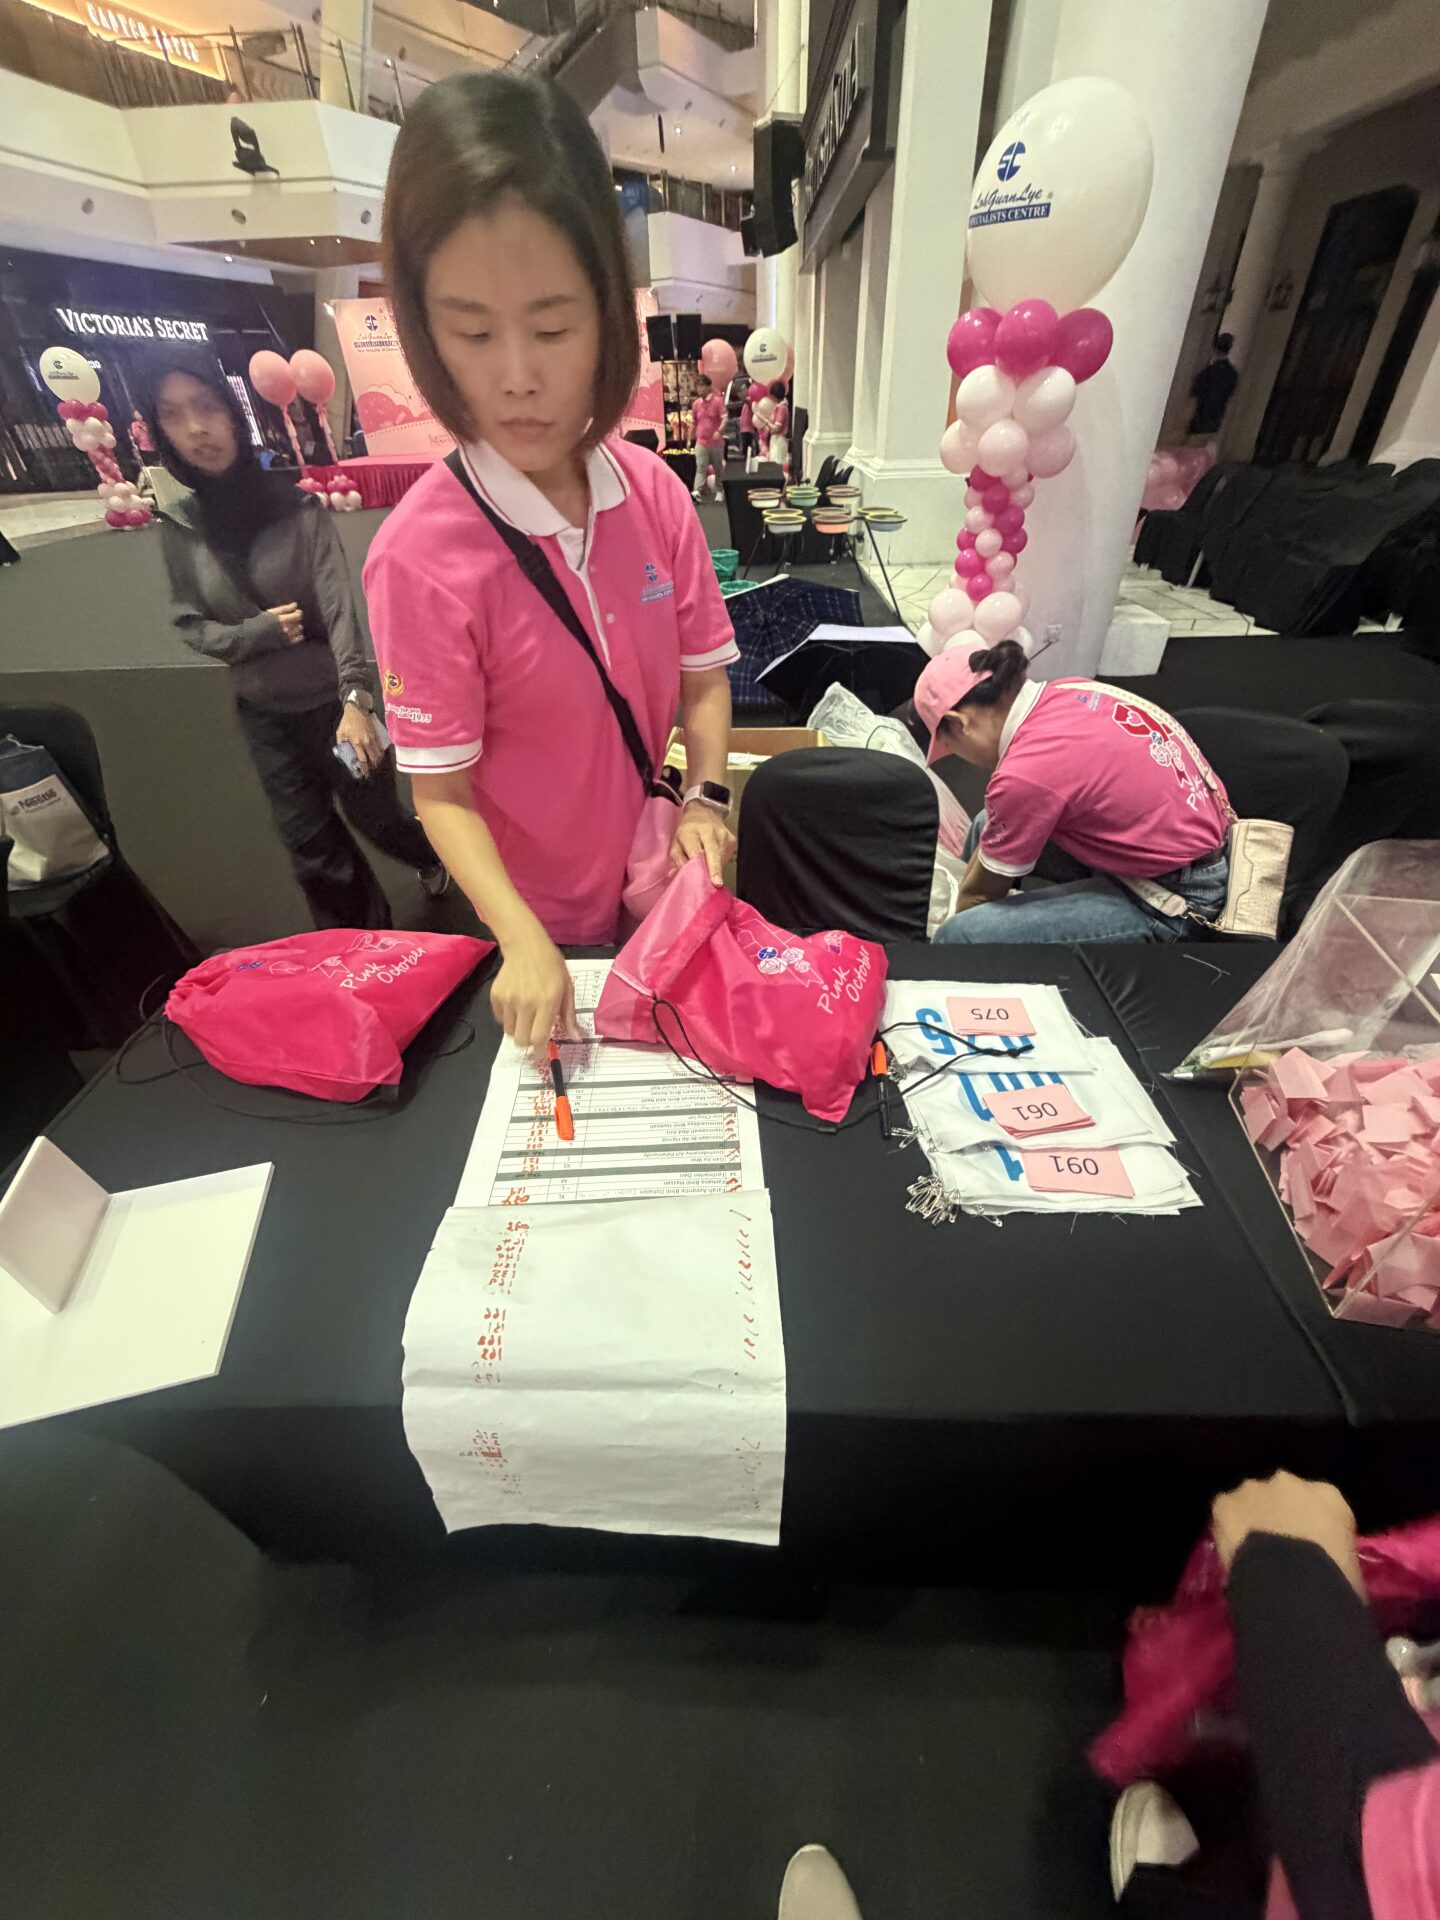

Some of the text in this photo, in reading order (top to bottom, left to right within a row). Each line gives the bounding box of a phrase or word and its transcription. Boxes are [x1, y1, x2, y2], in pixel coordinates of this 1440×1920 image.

[1008, 204, 1047, 220] CENTRE
[56, 308, 209, 341] VICTORIA'S SECRET
[340, 963, 386, 989] Pink
[377, 947, 427, 984] October
[817, 967, 850, 1014] Pink
[970, 1007, 1010, 1021] 075
[1012, 1101, 1058, 1121] 061
[1049, 1154, 1099, 1176] 091
